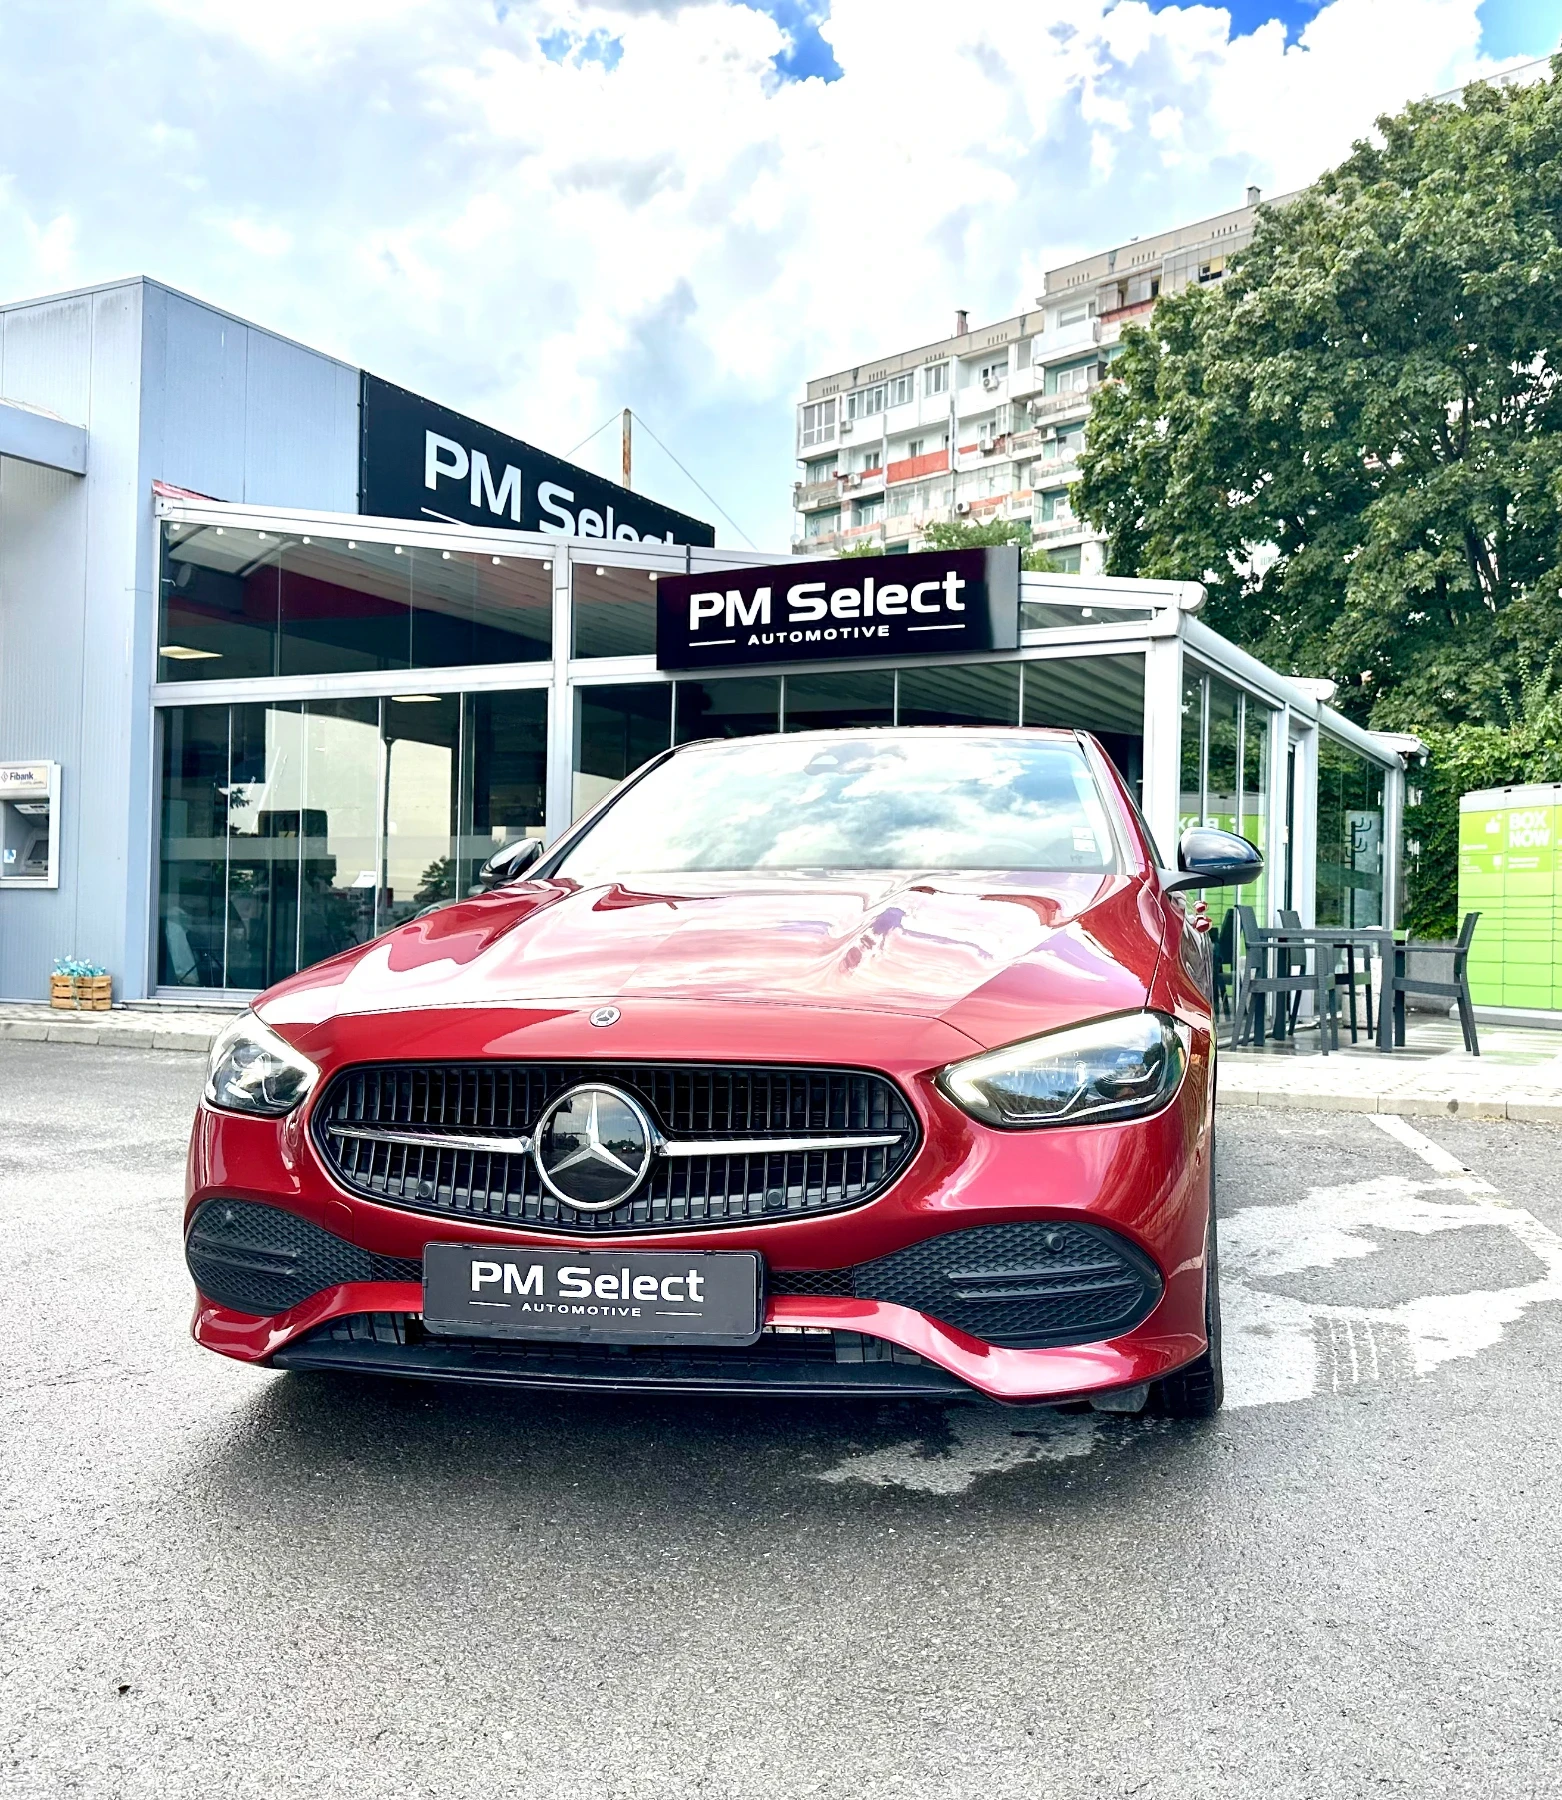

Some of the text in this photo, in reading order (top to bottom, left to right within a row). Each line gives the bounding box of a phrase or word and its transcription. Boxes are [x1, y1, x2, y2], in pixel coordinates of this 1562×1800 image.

[425, 429, 673, 546] PM Sel
[689, 571, 965, 630] PM Select
[748, 625, 890, 646] AUTOMOTIVE
[10, 771, 34, 780] Fibank
[1509, 810, 1547, 830] BOX
[1509, 829, 1550, 848] NOW
[471, 1260, 705, 1302] PM Select
[521, 1303, 642, 1317] AUTOMOTIVE
